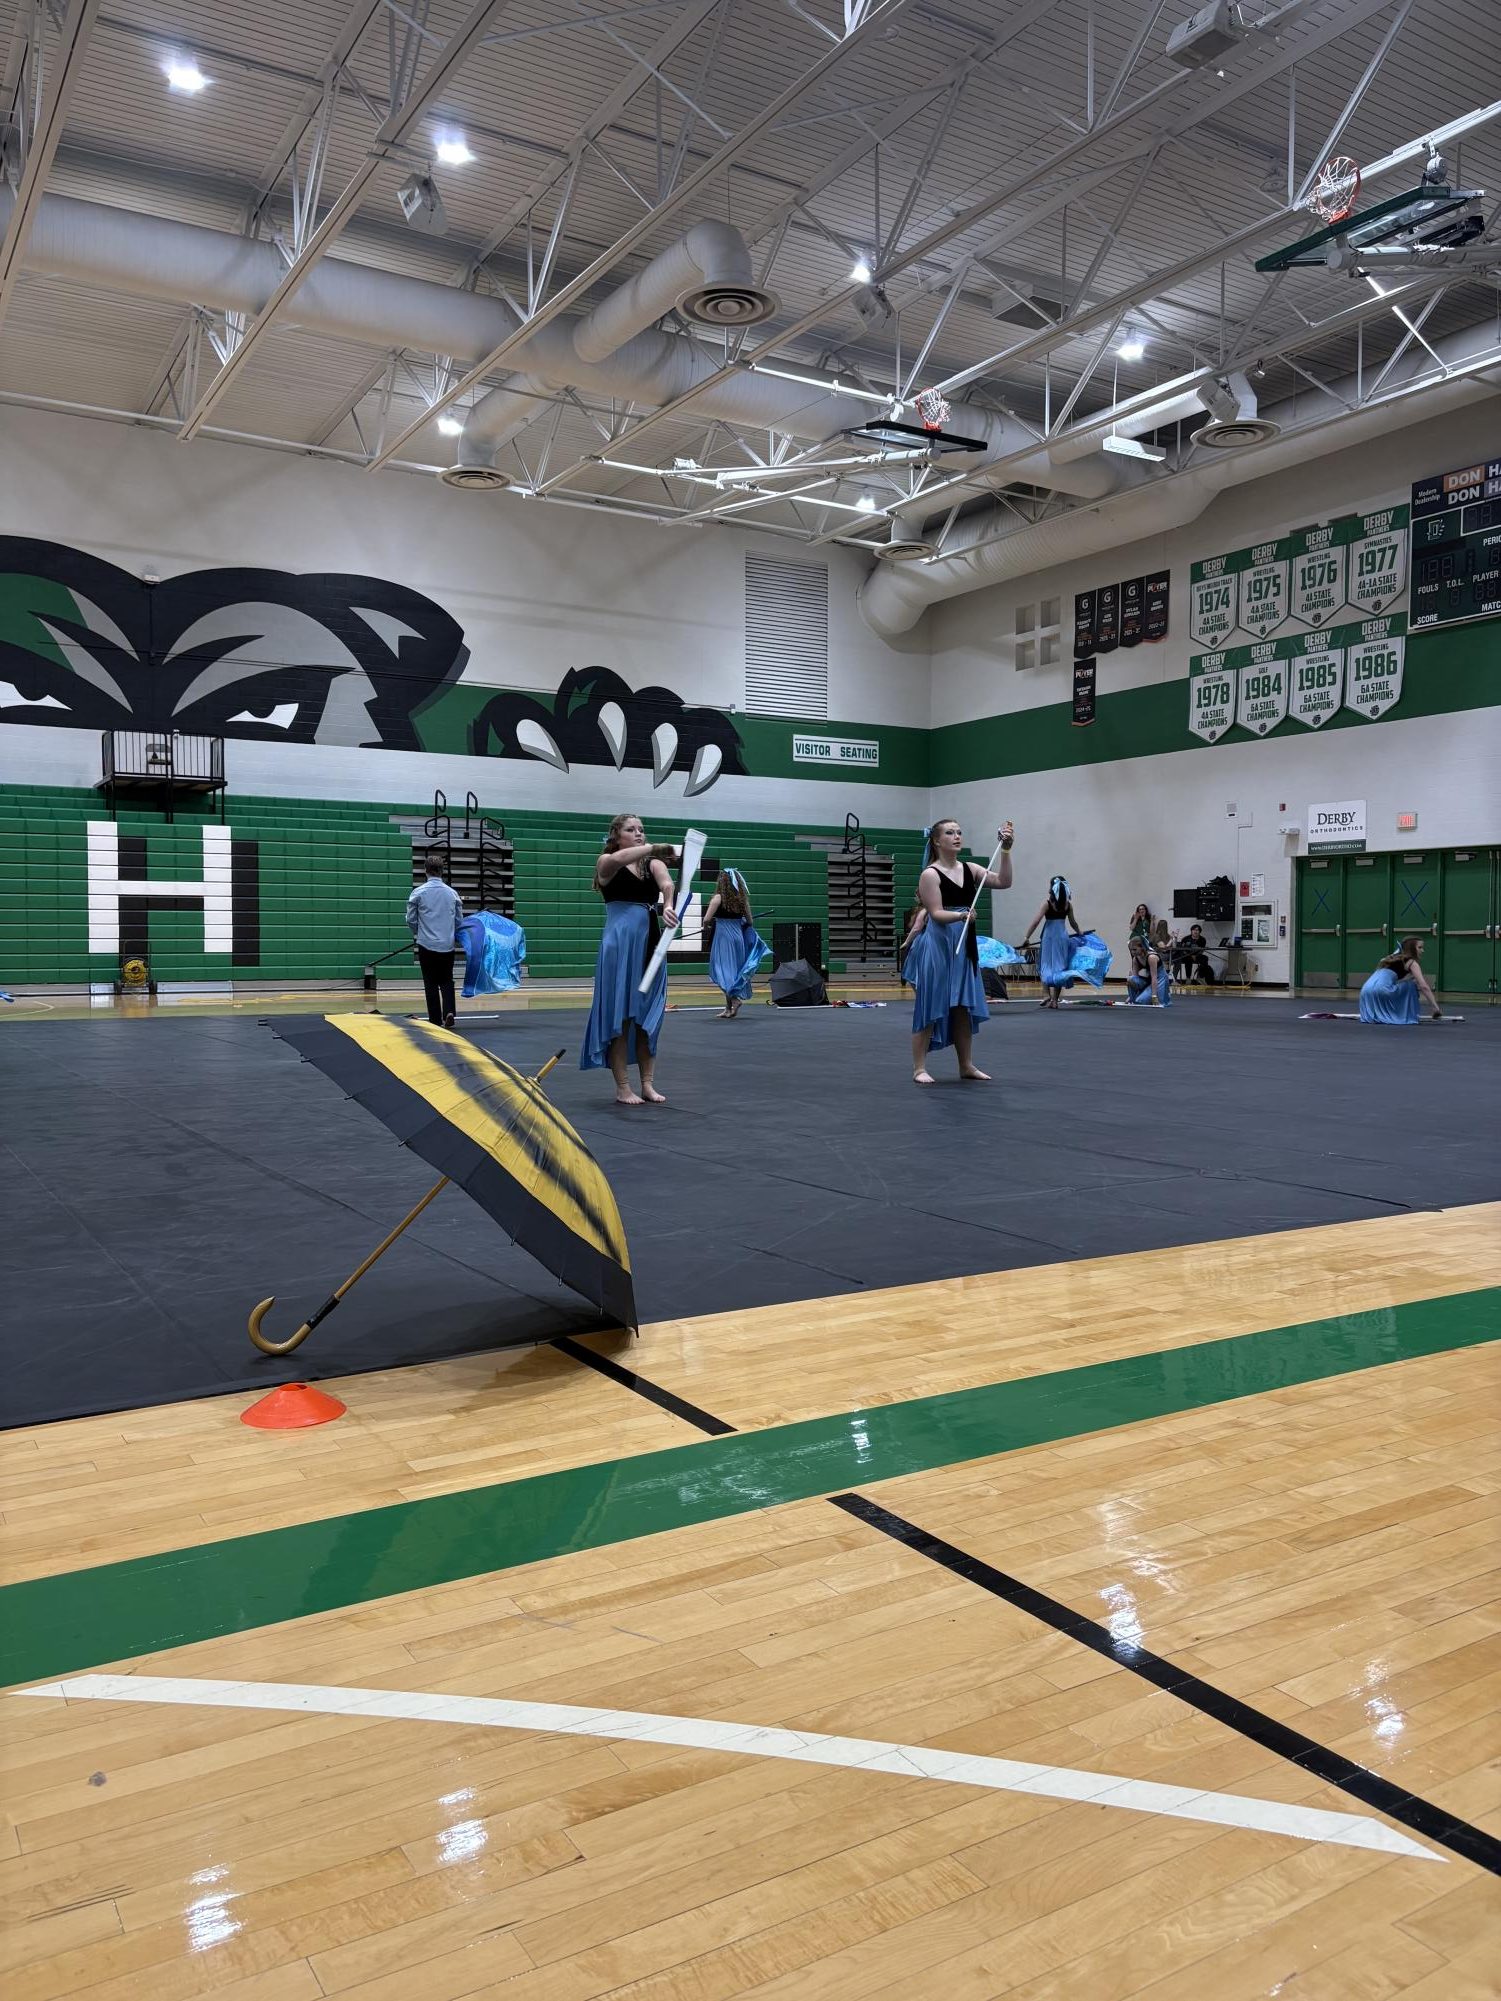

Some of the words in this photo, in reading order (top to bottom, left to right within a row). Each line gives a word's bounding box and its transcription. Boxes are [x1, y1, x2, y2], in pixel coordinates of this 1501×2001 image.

[1448, 469, 1480, 489] DON
[1488, 463, 1501, 478] H
[1414, 494, 1440, 506] Dealership
[1418, 488, 1437, 498] Modern
[1448, 485, 1480, 505] DON
[1488, 480, 1501, 494] H
[1363, 510, 1394, 531] DERBY
[1305, 527, 1334, 546] DERBY
[1364, 536, 1392, 549] GYMNASTICS
[1251, 541, 1277, 560] DERBY
[1202, 556, 1227, 574] DERBY
[1357, 543, 1399, 577] 1977
[1300, 560, 1337, 591] 1976
[1378, 573, 1397, 586] STATE
[1417, 583, 1439, 595] FOULS
[1472, 570, 1499, 583] PLAYER
[1246, 574, 1281, 603] 1975
[1313, 588, 1331, 600] STATE
[1357, 583, 1397, 600] CHAMPIONS
[1198, 586, 1231, 615] 1974
[1260, 601, 1276, 612] STATE
[1301, 597, 1335, 613] CHAMPIONS
[1210, 613, 1226, 624] STATE
[1246, 610, 1280, 624] CHAMPIONS
[1416, 613, 1438, 625] SCORE
[1198, 621, 1230, 635] CHAMPIONS
[1361, 617, 1392, 636] DERBY
[1304, 630, 1332, 648] DERBY
[1251, 641, 1277, 658] DERBY
[1363, 643, 1389, 654] WRESTLING
[1201, 652, 1226, 668] DERBY
[1305, 655, 1330, 665] WRESTLING
[1354, 650, 1398, 681] 1986
[1298, 662, 1337, 691] 1985
[1244, 672, 1282, 700] 1984
[1370, 680, 1390, 692] STATE
[1196, 682, 1230, 708] 1978
[1312, 691, 1330, 701] STATE
[1356, 689, 1394, 704] CHAMPIONS
[1209, 708, 1225, 718] STATE
[1259, 700, 1275, 710] STATE
[1299, 700, 1334, 714] CHAMPIONS
[1197, 717, 1228, 730] CHAMPIONS
[1246, 709, 1279, 722] CHAMPIONS
[795, 742, 831, 757] VISITOR
[840, 746, 878, 760] SEATING
[1316, 811, 1356, 826] DERBY
[1310, 826, 1363, 834] ORTHODONTICS
[87, 821, 233, 953] H
